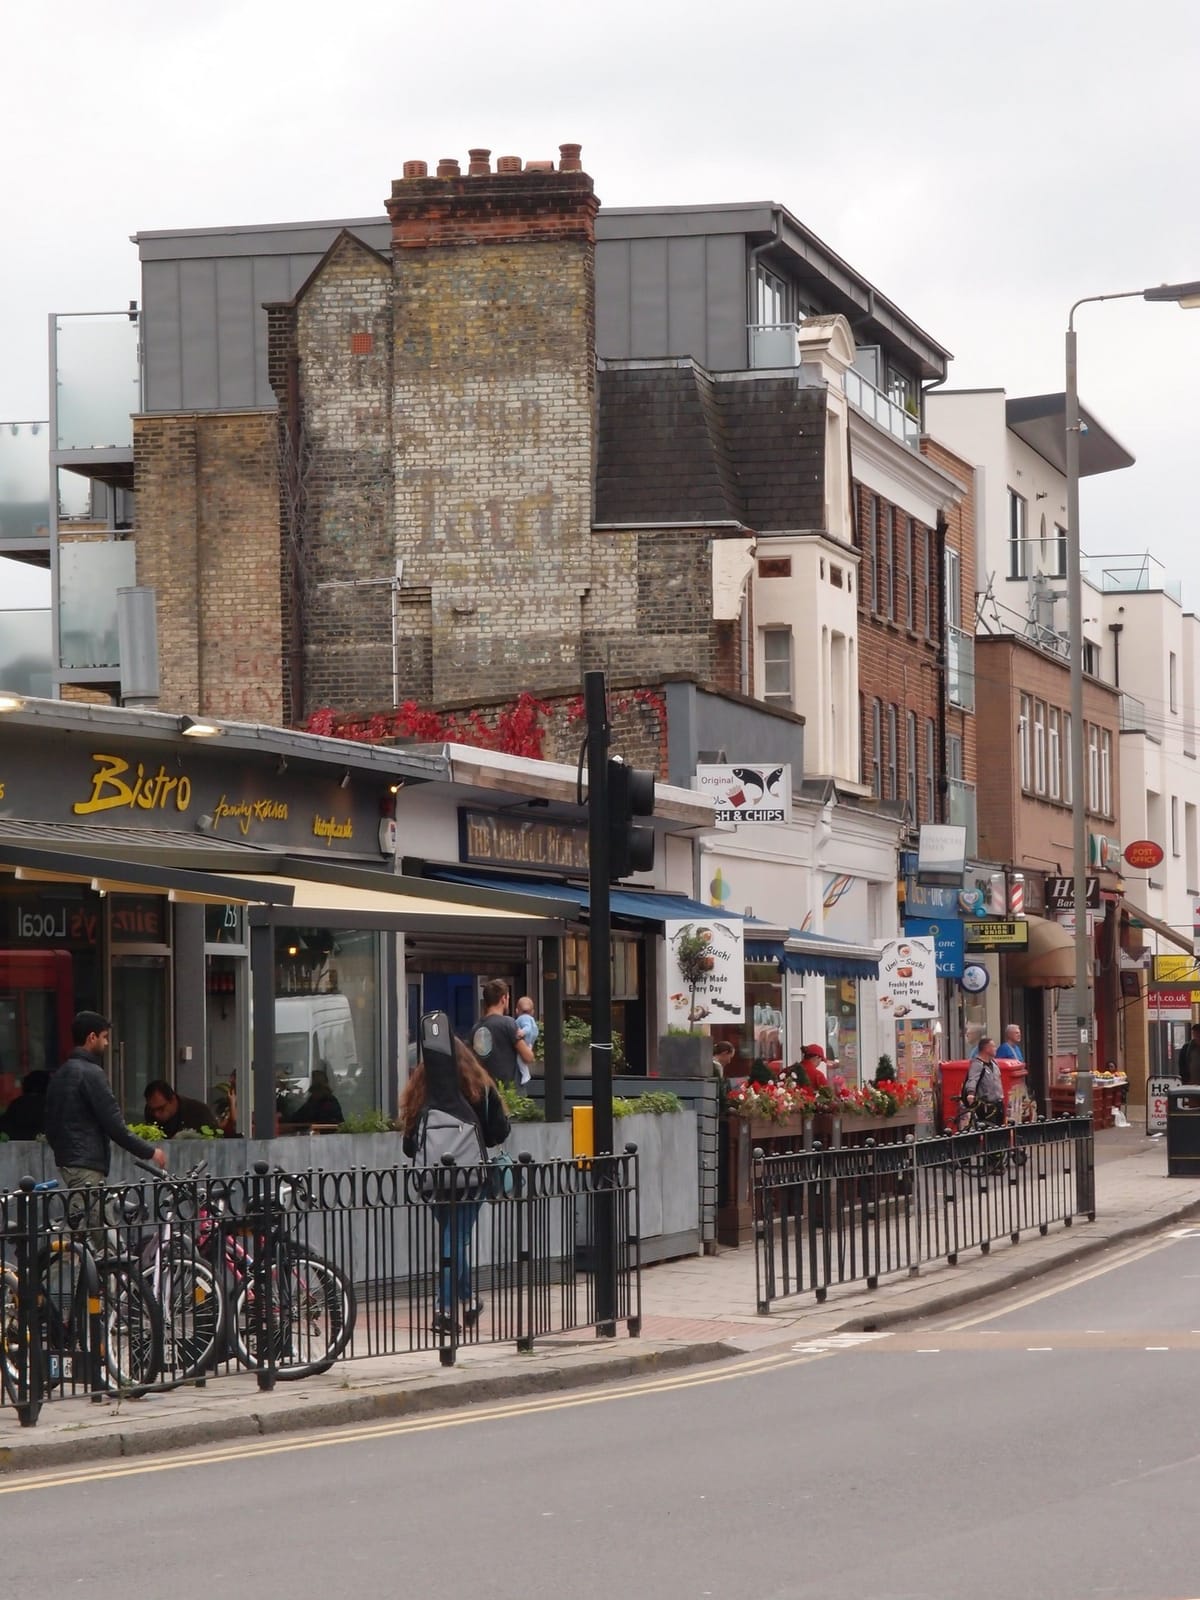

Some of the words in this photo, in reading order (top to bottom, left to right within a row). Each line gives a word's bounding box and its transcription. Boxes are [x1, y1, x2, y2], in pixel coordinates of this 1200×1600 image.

[73, 754, 191, 814] Bistro
[701, 776, 734, 786] Original
[715, 810, 730, 821] SH
[733, 810, 742, 821] &
[745, 810, 782, 821] CHIPS
[1131, 856, 1157, 864] OFFICE
[1057, 899, 1091, 908] Bars
[905, 958, 926, 969] Sushi
[709, 974, 728, 982] Made
[688, 985, 707, 994] Eery
[709, 985, 722, 993] Day
